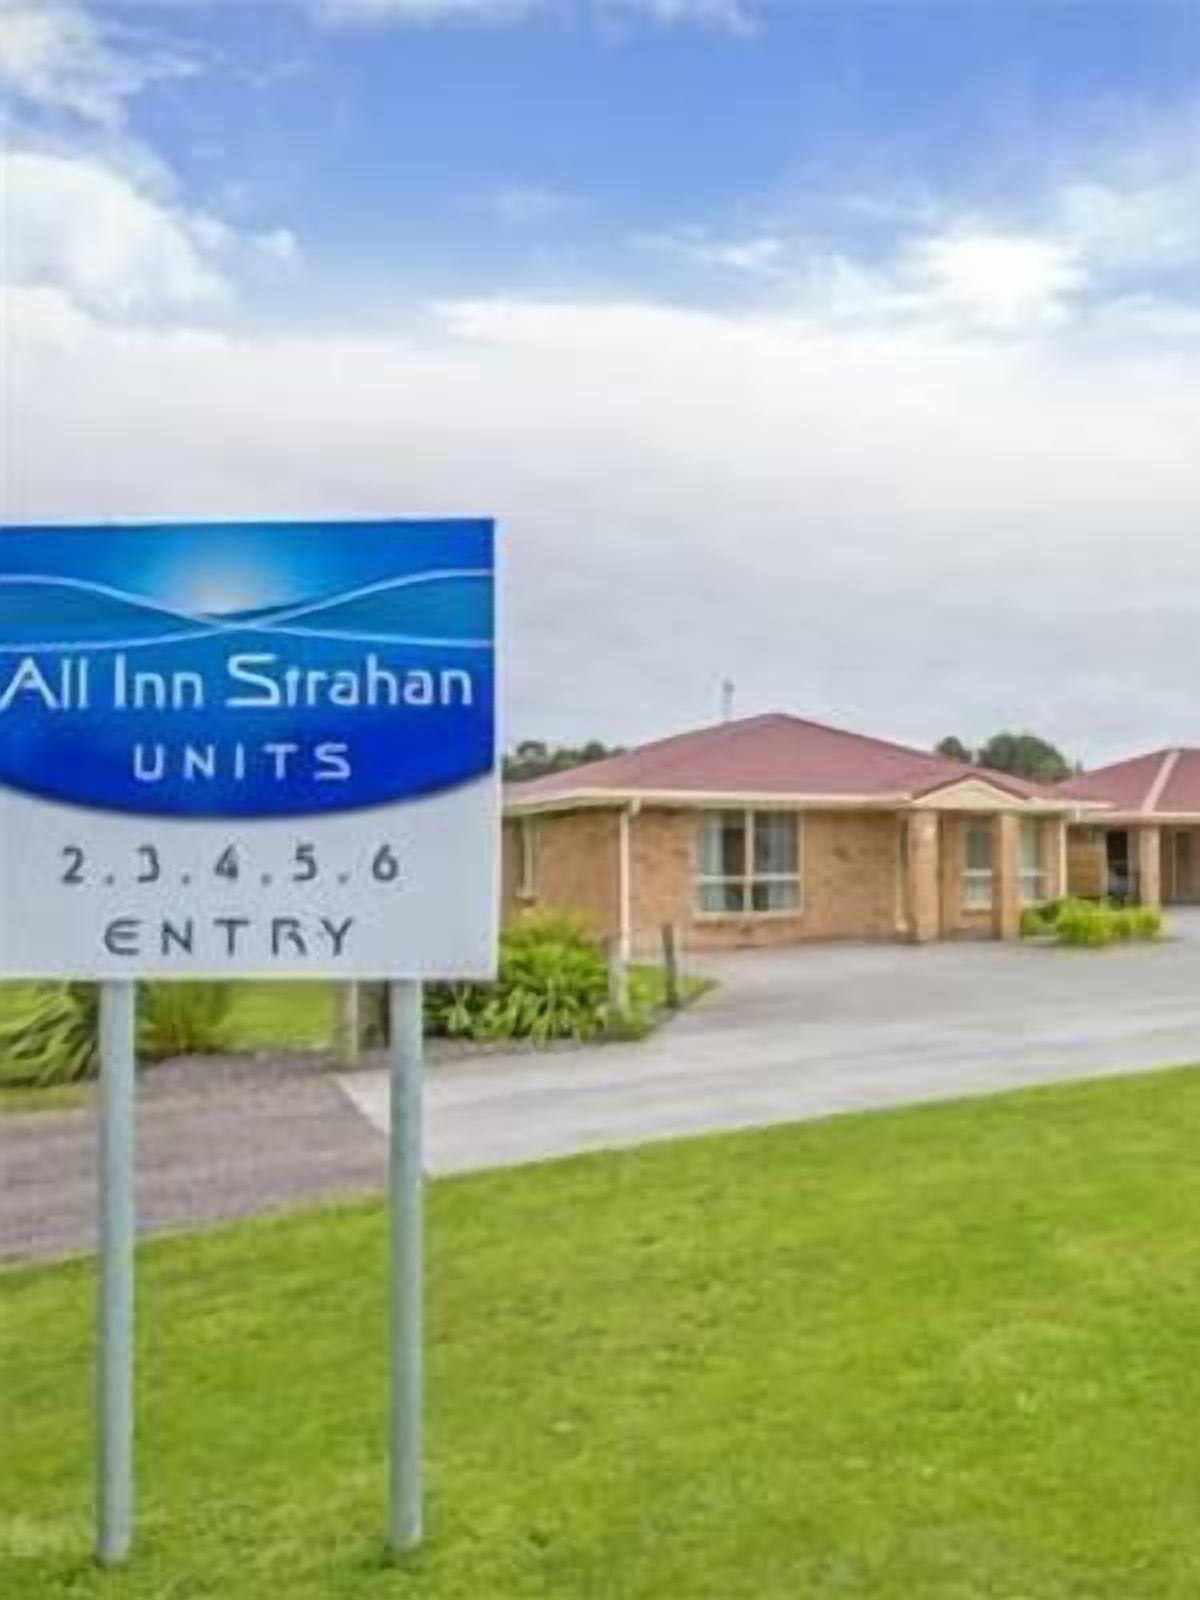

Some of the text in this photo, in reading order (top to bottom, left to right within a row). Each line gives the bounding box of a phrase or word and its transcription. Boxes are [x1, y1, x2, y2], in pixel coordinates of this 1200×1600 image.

[0, 653, 473, 711] All Inn Strahan
[133, 742, 352, 783] UNITS
[103, 917, 355, 957] ENTRY
